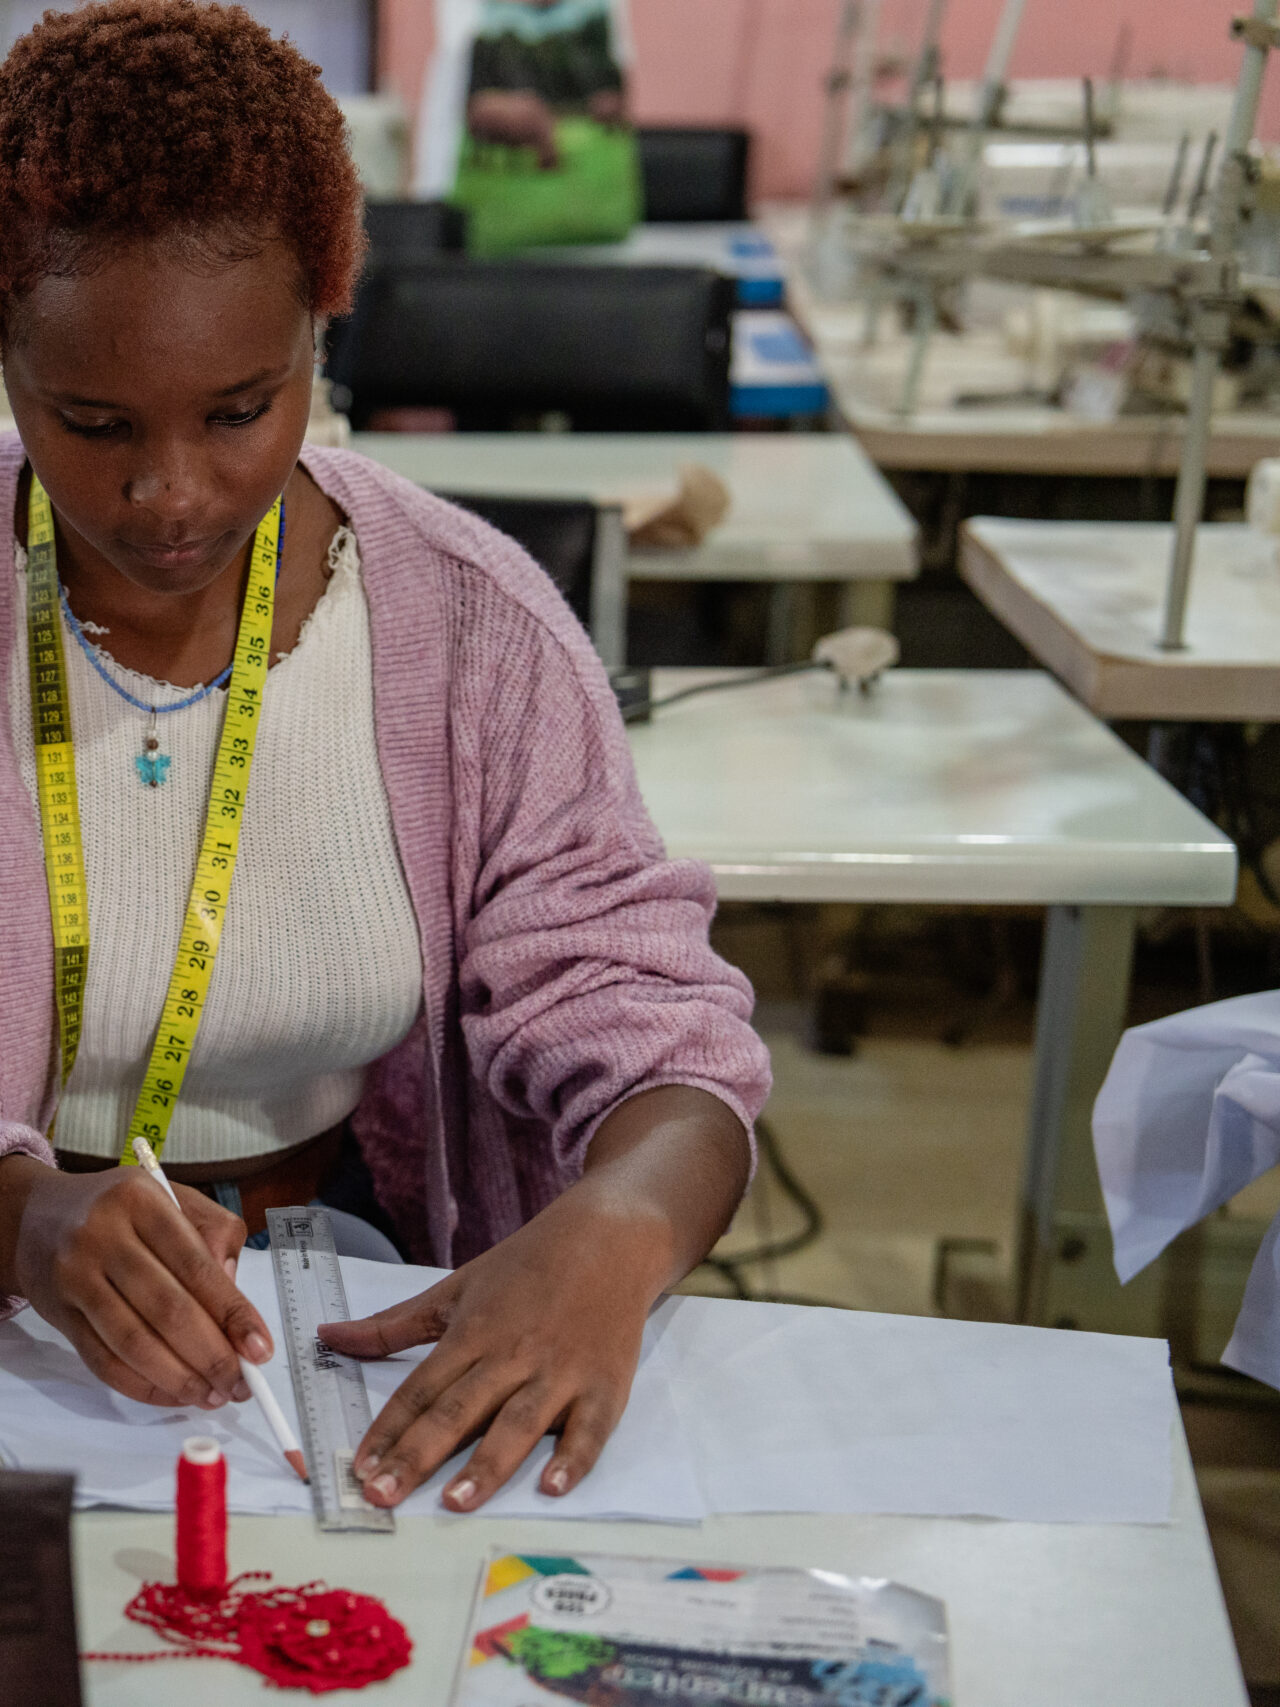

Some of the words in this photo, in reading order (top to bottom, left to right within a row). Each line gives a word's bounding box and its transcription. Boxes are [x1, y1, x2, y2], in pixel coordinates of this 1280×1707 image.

[261, 536, 275, 567] 37
[255, 586, 271, 616] 36
[35, 610, 50, 622] 124
[37, 630, 52, 642] 125
[39, 650, 55, 662] 126
[247, 637, 265, 666] 35
[40, 670, 56, 682] 127
[41, 690, 58, 702] 128
[239, 688, 258, 718] 34
[43, 710, 60, 722] 129
[44, 731, 62, 743] 130
[47, 752, 63, 763] 131
[229, 737, 249, 769] 33
[49, 772, 65, 783] 132
[51, 791, 67, 804] 133
[221, 788, 240, 819] 32
[53, 812, 69, 824] 134
[55, 833, 72, 844] 135
[57, 853, 73, 865] 136
[211, 841, 233, 870] 31
[58, 873, 75, 885] 137
[61, 893, 77, 905] 138
[201, 889, 221, 920] 30
[63, 913, 79, 926] 139
[65, 934, 81, 945] 140
[65, 954, 80, 965] 141
[189, 939, 210, 970] 29
[177, 988, 199, 1018] 28
[164, 1035, 186, 1063] 27
[151, 1079, 174, 1108] 26
